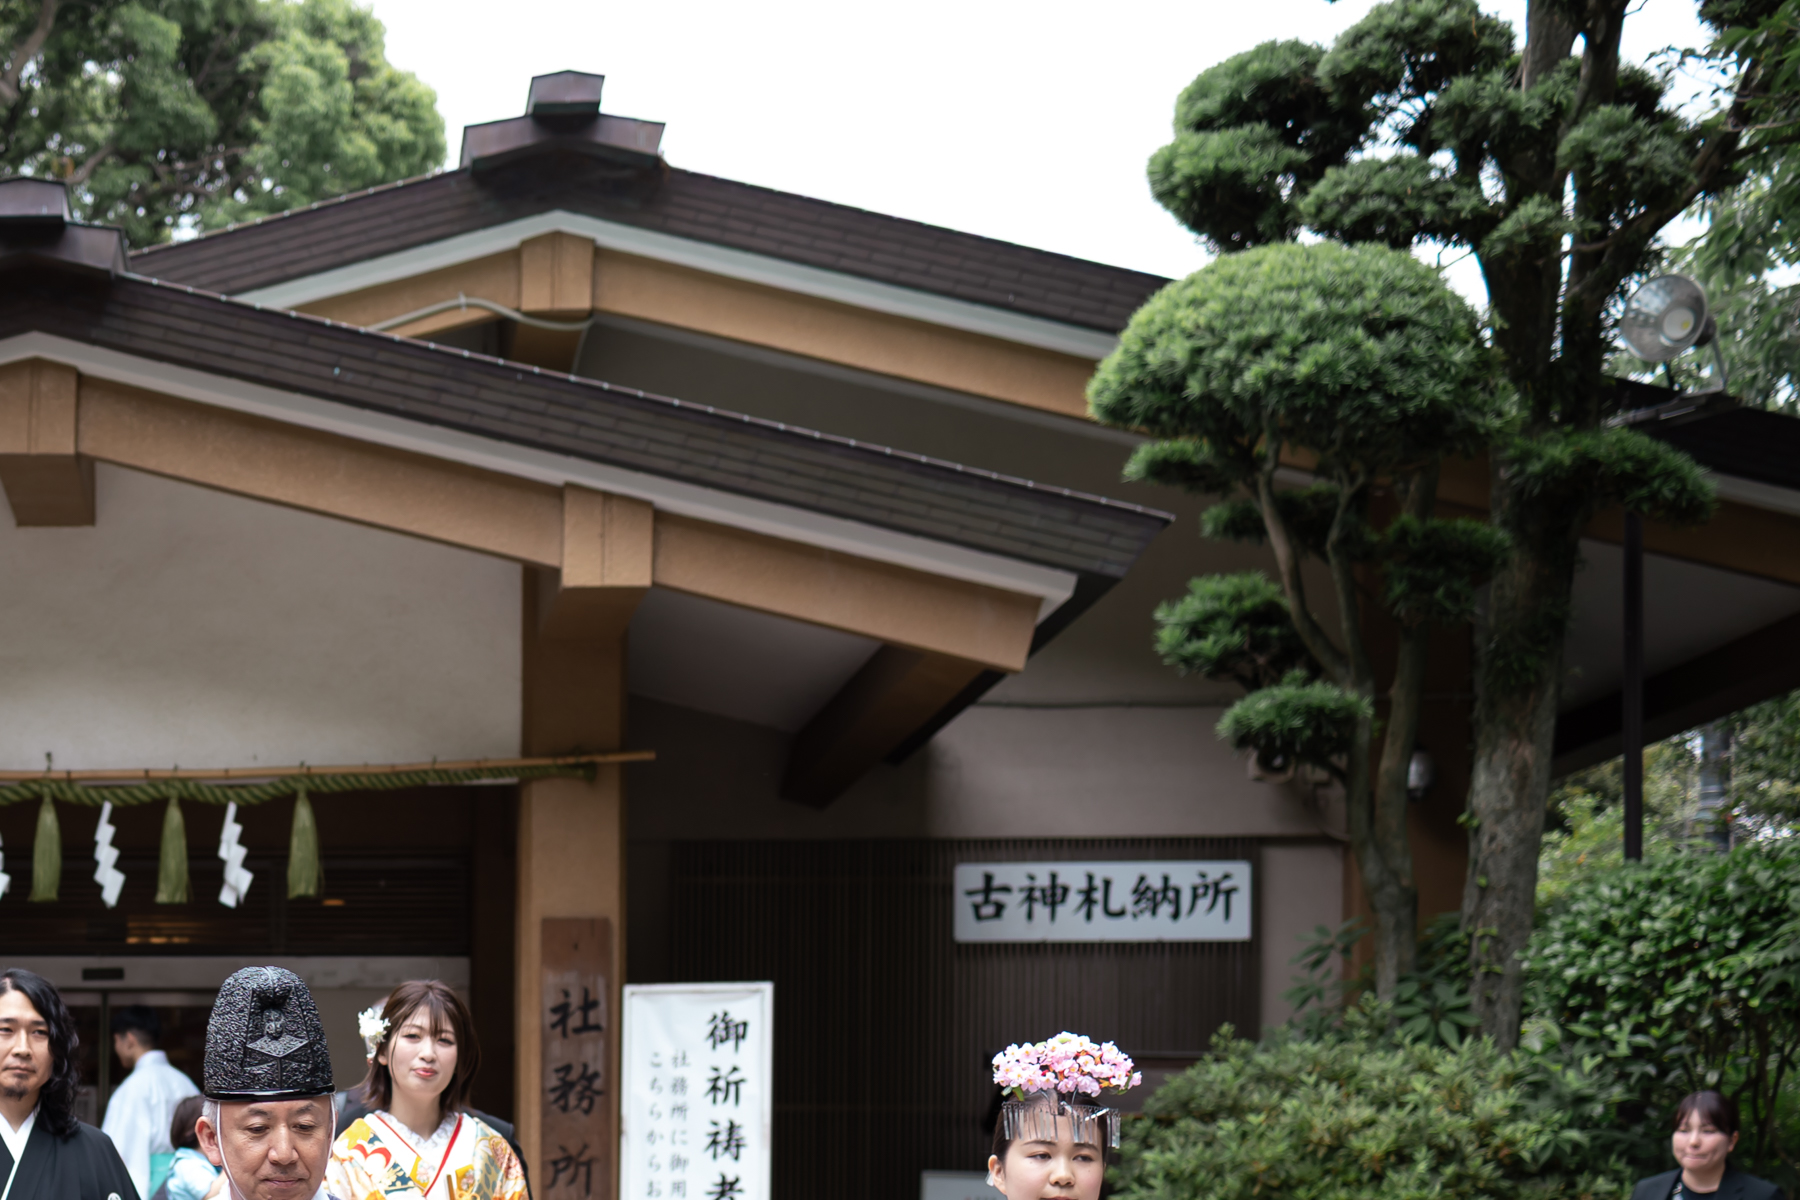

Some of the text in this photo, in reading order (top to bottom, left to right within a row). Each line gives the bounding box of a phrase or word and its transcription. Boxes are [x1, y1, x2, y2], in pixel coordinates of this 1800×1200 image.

[964, 871, 1239, 925] 古神札納所
[547, 986, 604, 1198] 社務所
